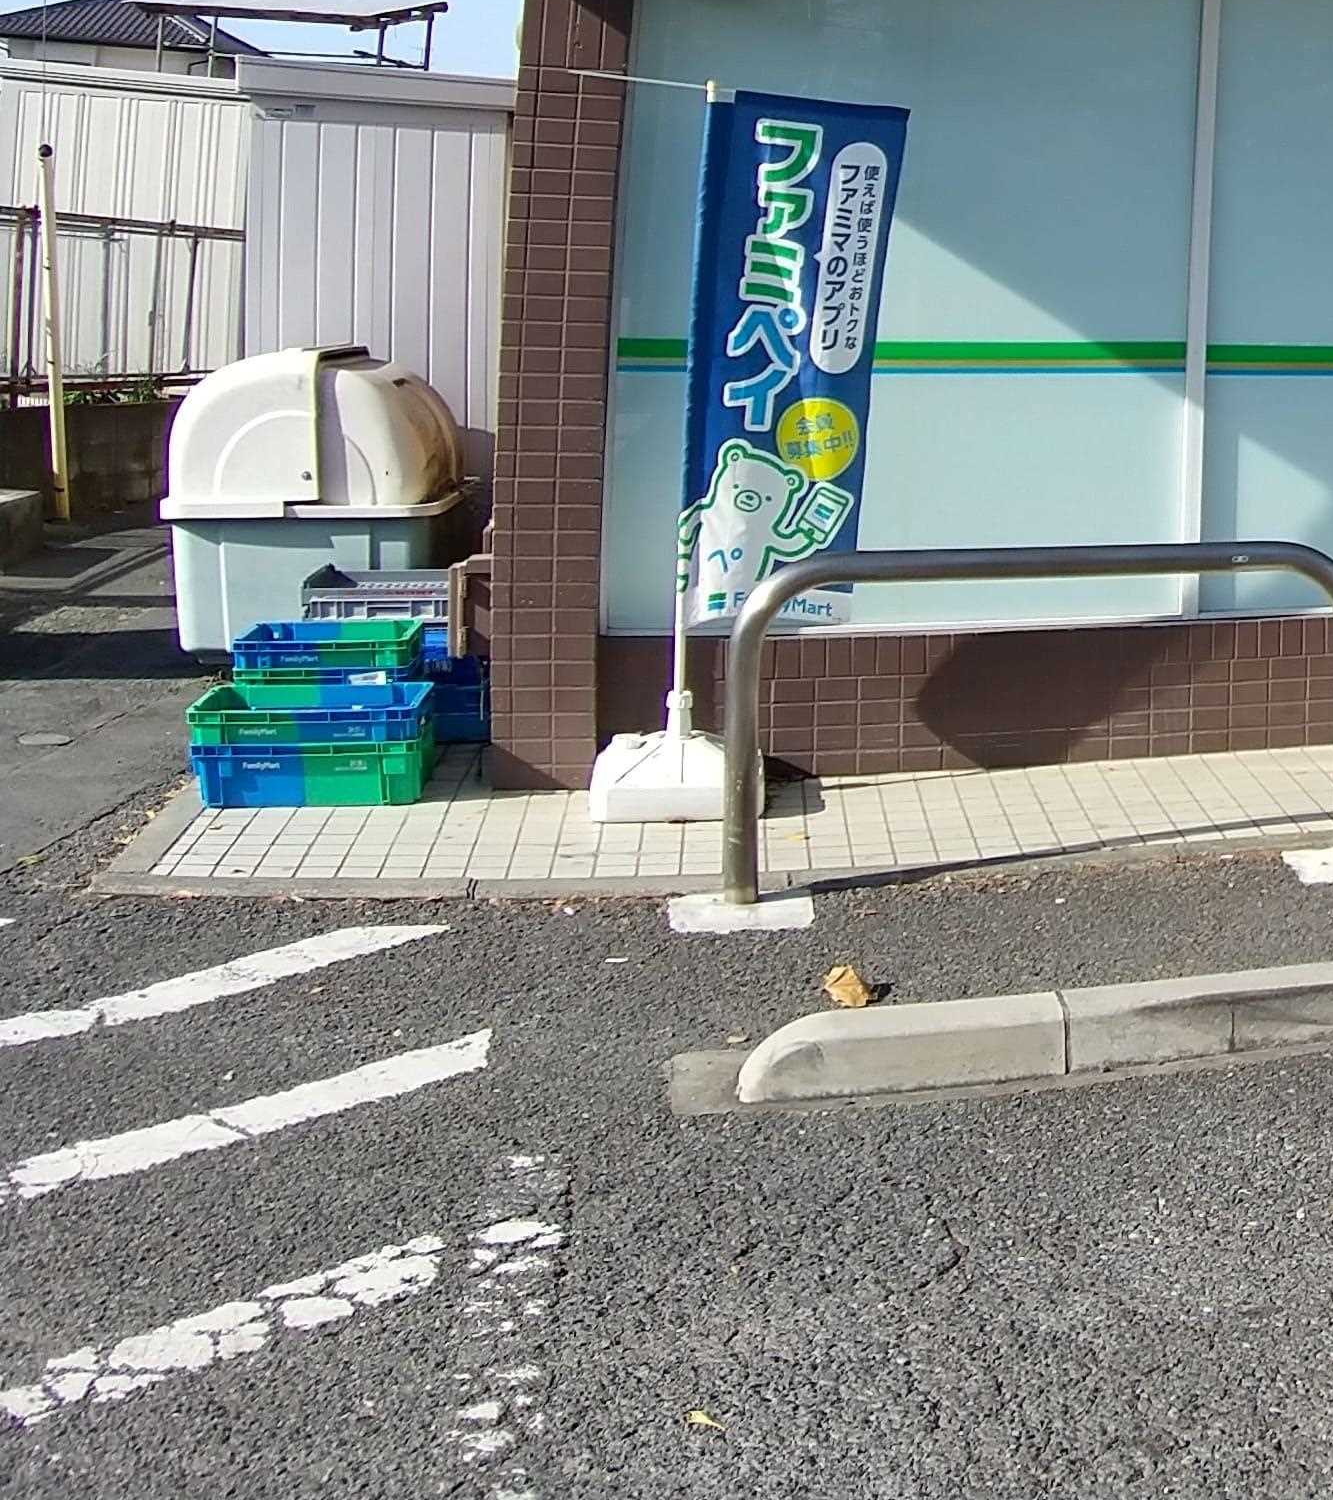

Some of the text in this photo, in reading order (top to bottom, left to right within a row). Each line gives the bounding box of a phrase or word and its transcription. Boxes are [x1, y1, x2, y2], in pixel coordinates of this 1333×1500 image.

[725, 119, 822, 431] ファミペイ
[820, 163, 860, 352] ファミマのアプリ
[844, 164, 881, 351] 使えば使うほどおトクな
[733, 591, 833, 617] FyMart
